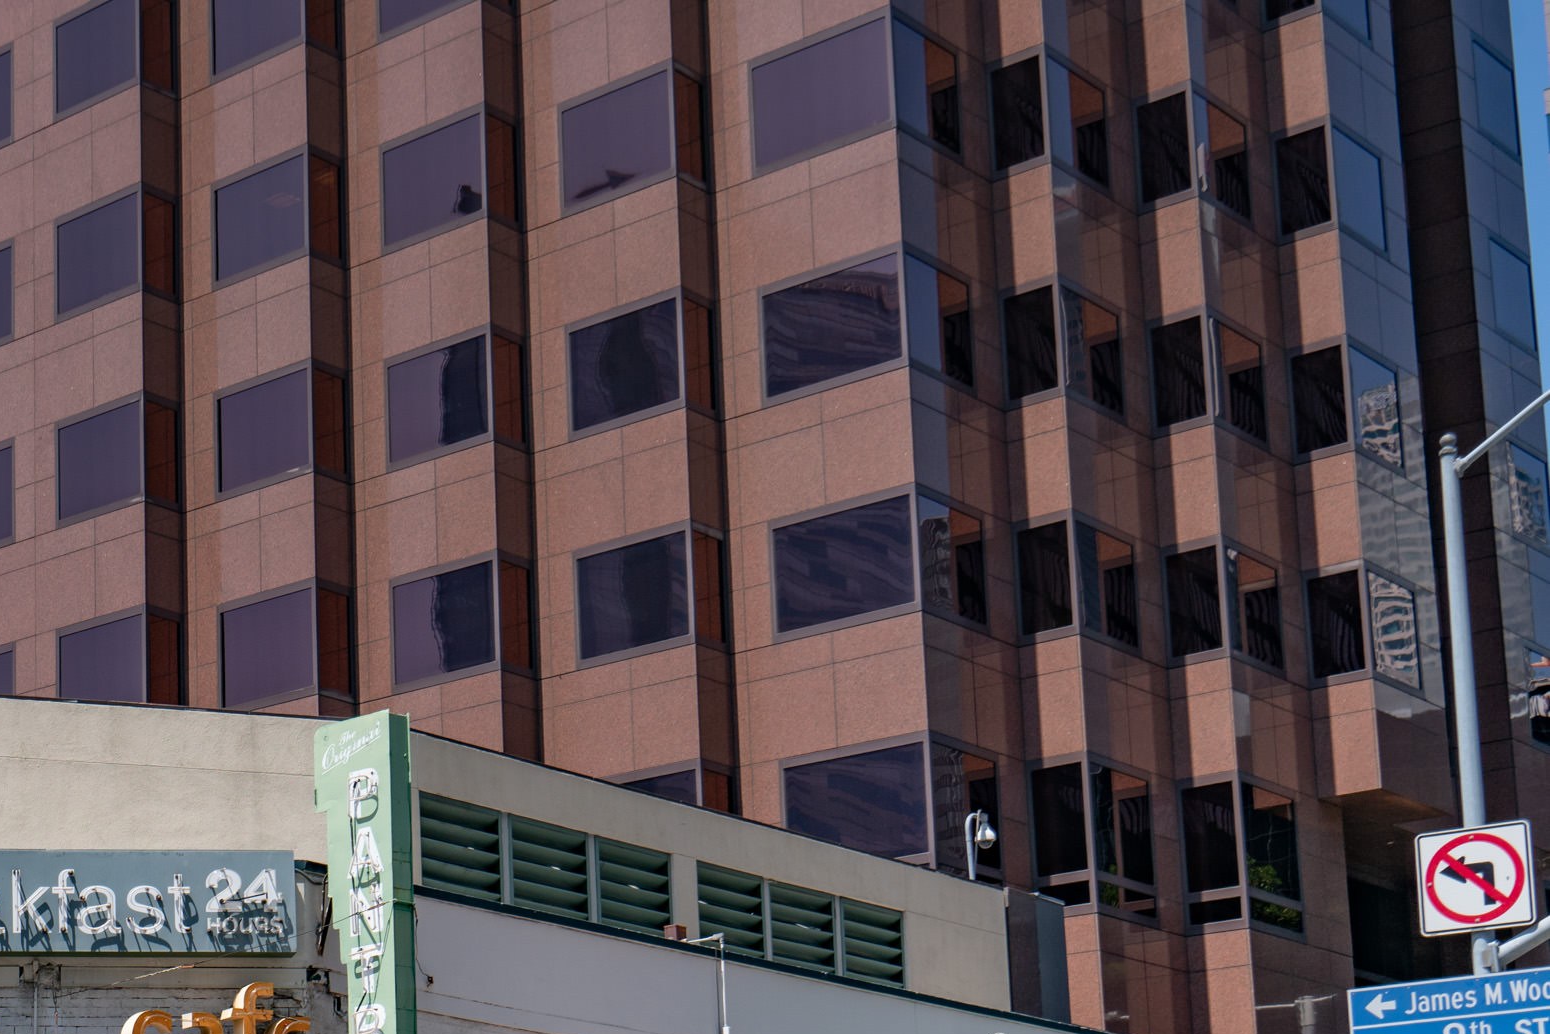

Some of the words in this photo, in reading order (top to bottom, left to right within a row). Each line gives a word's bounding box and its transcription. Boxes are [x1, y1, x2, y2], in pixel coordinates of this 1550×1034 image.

[321, 720, 382, 773] Original
[204, 868, 284, 914] 24
[206, 915, 284, 936] HOURS
[1405, 990, 1478, 1015] James
[1484, 982, 1508, 1006] M.
